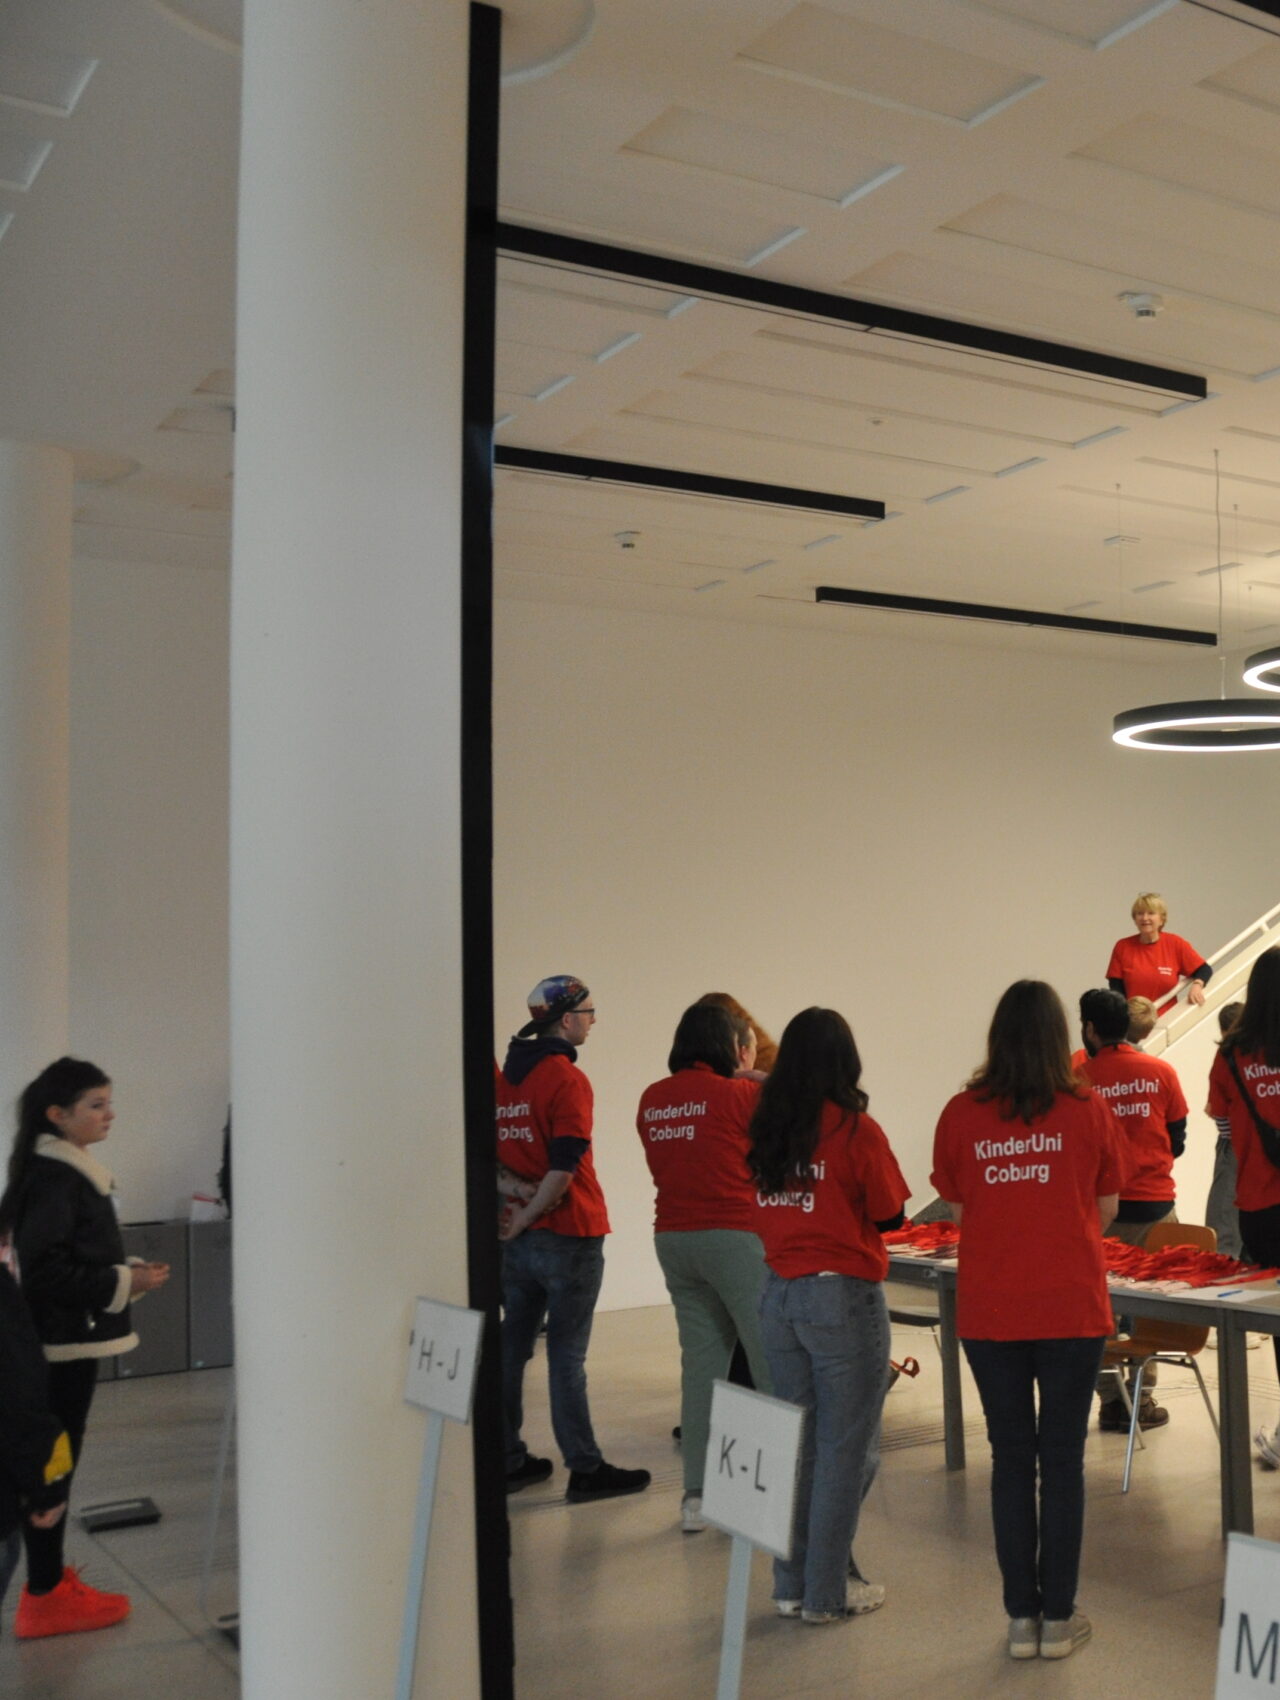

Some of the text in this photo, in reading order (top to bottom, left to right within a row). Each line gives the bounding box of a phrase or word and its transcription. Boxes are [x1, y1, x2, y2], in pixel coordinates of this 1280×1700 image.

[1092, 1079, 1160, 1098] inderUni
[644, 1101, 707, 1122] KinderUni
[1112, 1102, 1150, 1117] burg
[649, 1125, 695, 1142] Coburg
[974, 1132, 1063, 1161] KinderUni
[984, 1163, 1050, 1185] Coburg
